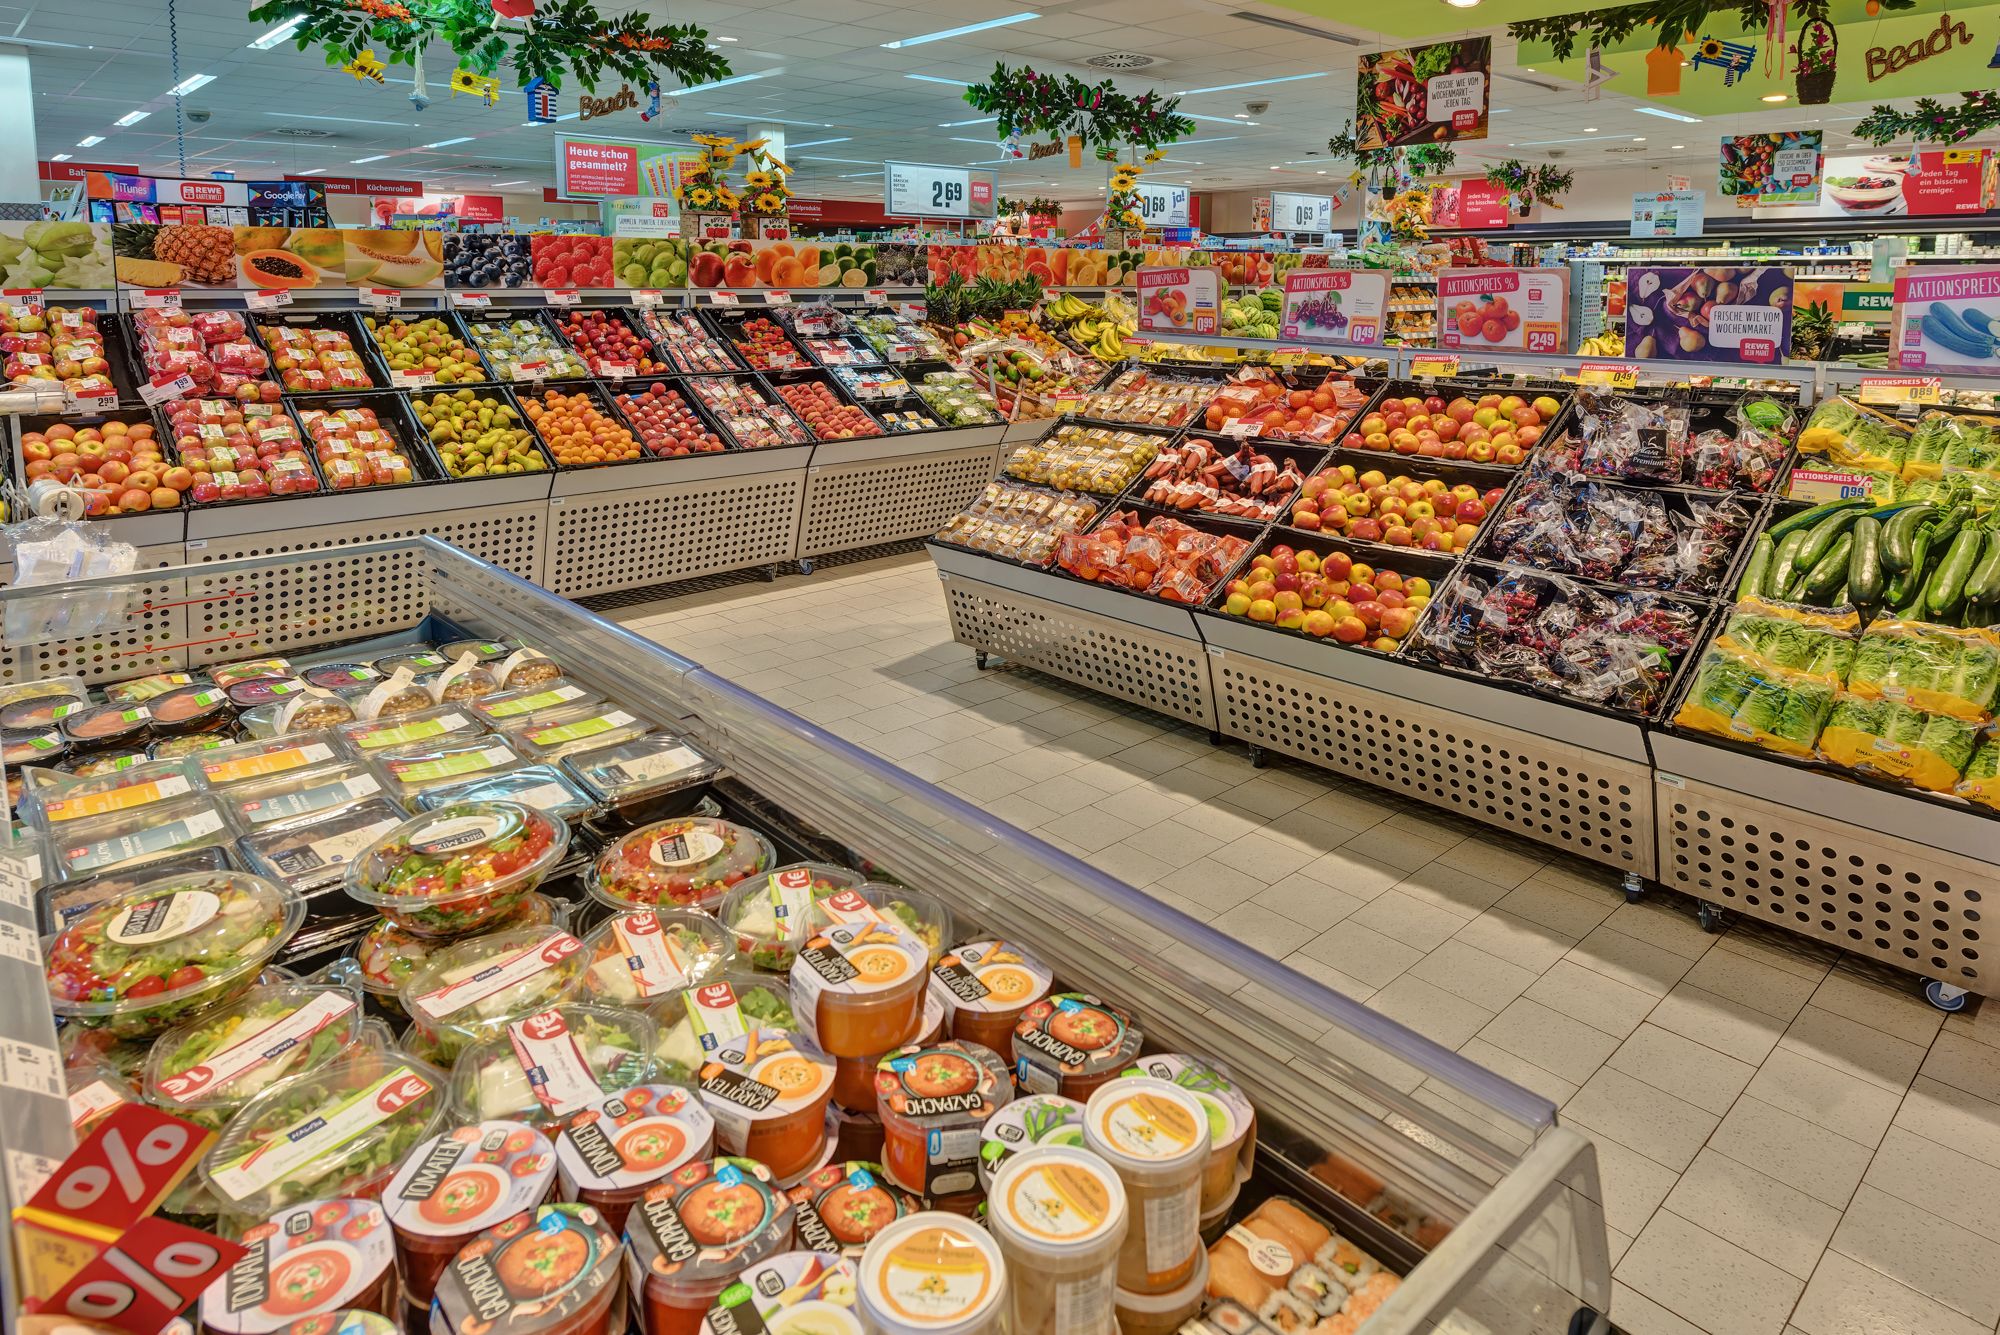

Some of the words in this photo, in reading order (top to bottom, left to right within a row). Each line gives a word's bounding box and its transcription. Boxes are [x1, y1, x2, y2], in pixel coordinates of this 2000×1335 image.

[1866, 14, 1974, 82] Beach
[1435, 80, 1454, 90] FRISCHE
[1456, 78, 1466, 87] WIE
[1468, 77, 1479, 86] VOM
[580, 84, 639, 121] Beach
[1444, 98, 1459, 108] JEDEN
[1456, 113, 1474, 121] REWE
[570, 146, 598, 158] Heute
[600, 150, 628, 160] schon
[570, 160, 628, 172] gesammelt?
[264, 191, 294, 202] Google
[367, 184, 414, 193] Küchenrollen
[932, 181, 962, 208] 2.69
[1919, 188, 1954, 196] cremiger.
[1172, 190, 1185, 208] ja!
[1296, 206, 1313, 226] 0.63
[1319, 201, 1329, 217] ja!
[1142, 273, 1179, 286] AKTIONSPREIS
[1180, 272, 1187, 283] %
[1292, 276, 1337, 290] AKTIONSPREIS
[1340, 277, 1347, 287] %
[1447, 277, 1502, 294] AKTIONSPREIS
[1504, 277, 1515, 290] %
[1908, 276, 2000, 298] AKTIONSPREIS
[22, 296, 38, 304] 0.99
[164, 296, 178, 304] 2.99
[1859, 296, 1894, 307] REW
[1714, 311, 1743, 321] FRISCHE
[1746, 312, 1760, 321] WIE
[1763, 312, 1780, 322] VOM
[1197, 317, 1214, 333] 0.99
[1716, 324, 1774, 335] WOCHENMARKT.
[1353, 326, 1374, 342] 0.49
[1530, 332, 1555, 351] 2.49
[1613, 373, 1632, 382] 0.49
[1626, 365, 1639, 374] %
[175, 378, 189, 389] 1.99
[1922, 377, 1940, 387] %
[1909, 388, 1933, 399] 0.89
[99, 397, 115, 407] 2.99
[1245, 424, 1258, 433] 2.99
[1633, 456, 1665, 466] Premium
[1793, 472, 1852, 482] AKTIONSPREIS
[1854, 475, 1872, 488] %
[1840, 486, 1865, 499] 0.99
[436, 832, 483, 850] BBQ-MIX
[786, 869, 807, 887] 1€
[834, 891, 862, 912] 1€
[545, 938, 580, 962] 1€
[803, 946, 850, 985] KAROTTEN
[936, 964, 982, 1003] KAROTTEN
[706, 984, 731, 1006] 1€
[1021, 1027, 1086, 1067] GAZPACHO
[161, 1068, 210, 1095] 1€
[382, 1074, 424, 1110] 1€
[700, 1077, 768, 1111] KAROTTEN
[904, 1091, 982, 1117] GAZPACHO
[569, 1124, 620, 1177] TOMATEN
[56, 1123, 189, 1210] %
[405, 1137, 463, 1199] TOMATEN
[646, 1199, 695, 1262] GAZPACHO
[66, 1241, 219, 1318] %
[457, 1255, 509, 1320] GAZPACHO
